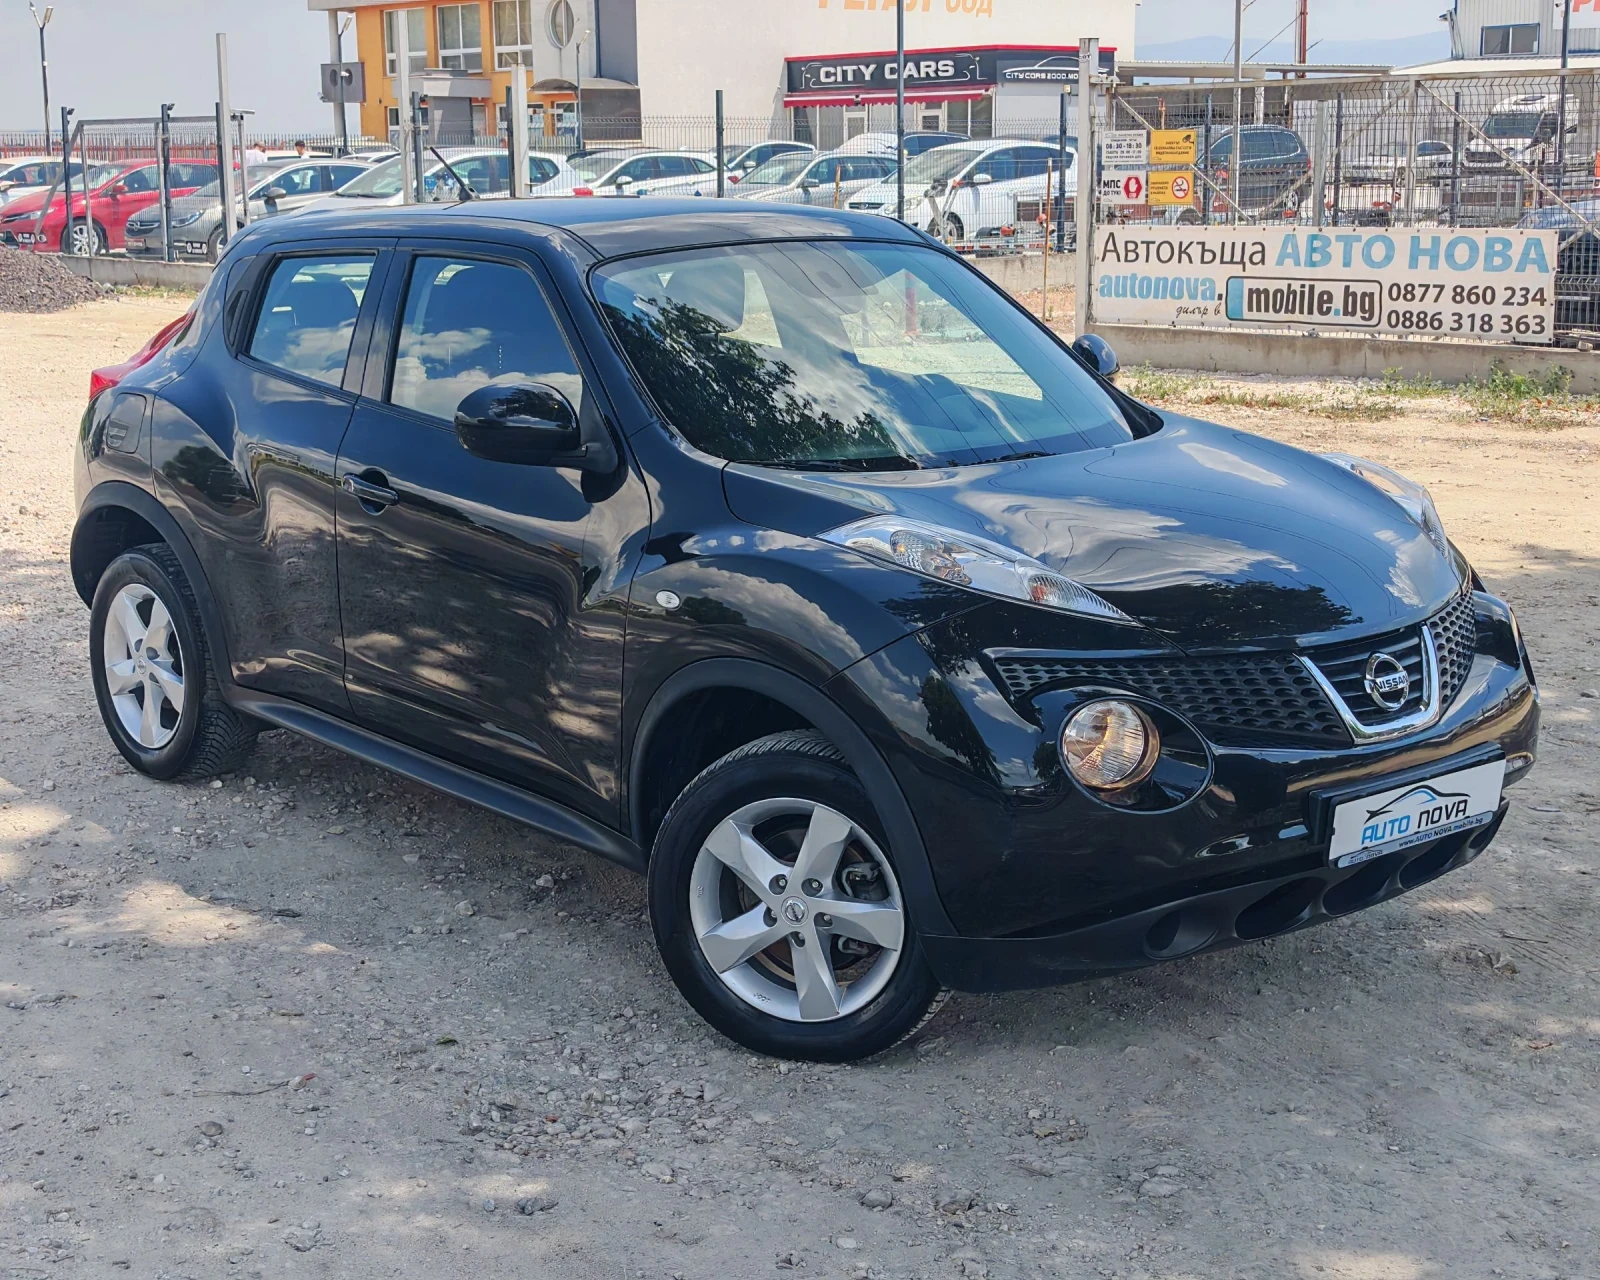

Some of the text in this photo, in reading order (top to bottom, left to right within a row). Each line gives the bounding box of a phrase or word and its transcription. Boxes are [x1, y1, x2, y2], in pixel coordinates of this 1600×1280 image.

[819, 60, 955, 83] CITY CARS
[1102, 180, 1121, 189] МПС
[1101, 232, 1550, 274] Автокъща АВТО НОВА
[1247, 283, 1375, 322] mobile.bg
[1388, 283, 1547, 307] 0877 860 234
[1175, 304, 1209, 319] дилър
[1387, 309, 1546, 335] 0886 318 363
[1374, 674, 1408, 691] NISSAN
[1361, 814, 1411, 845] AUTO
